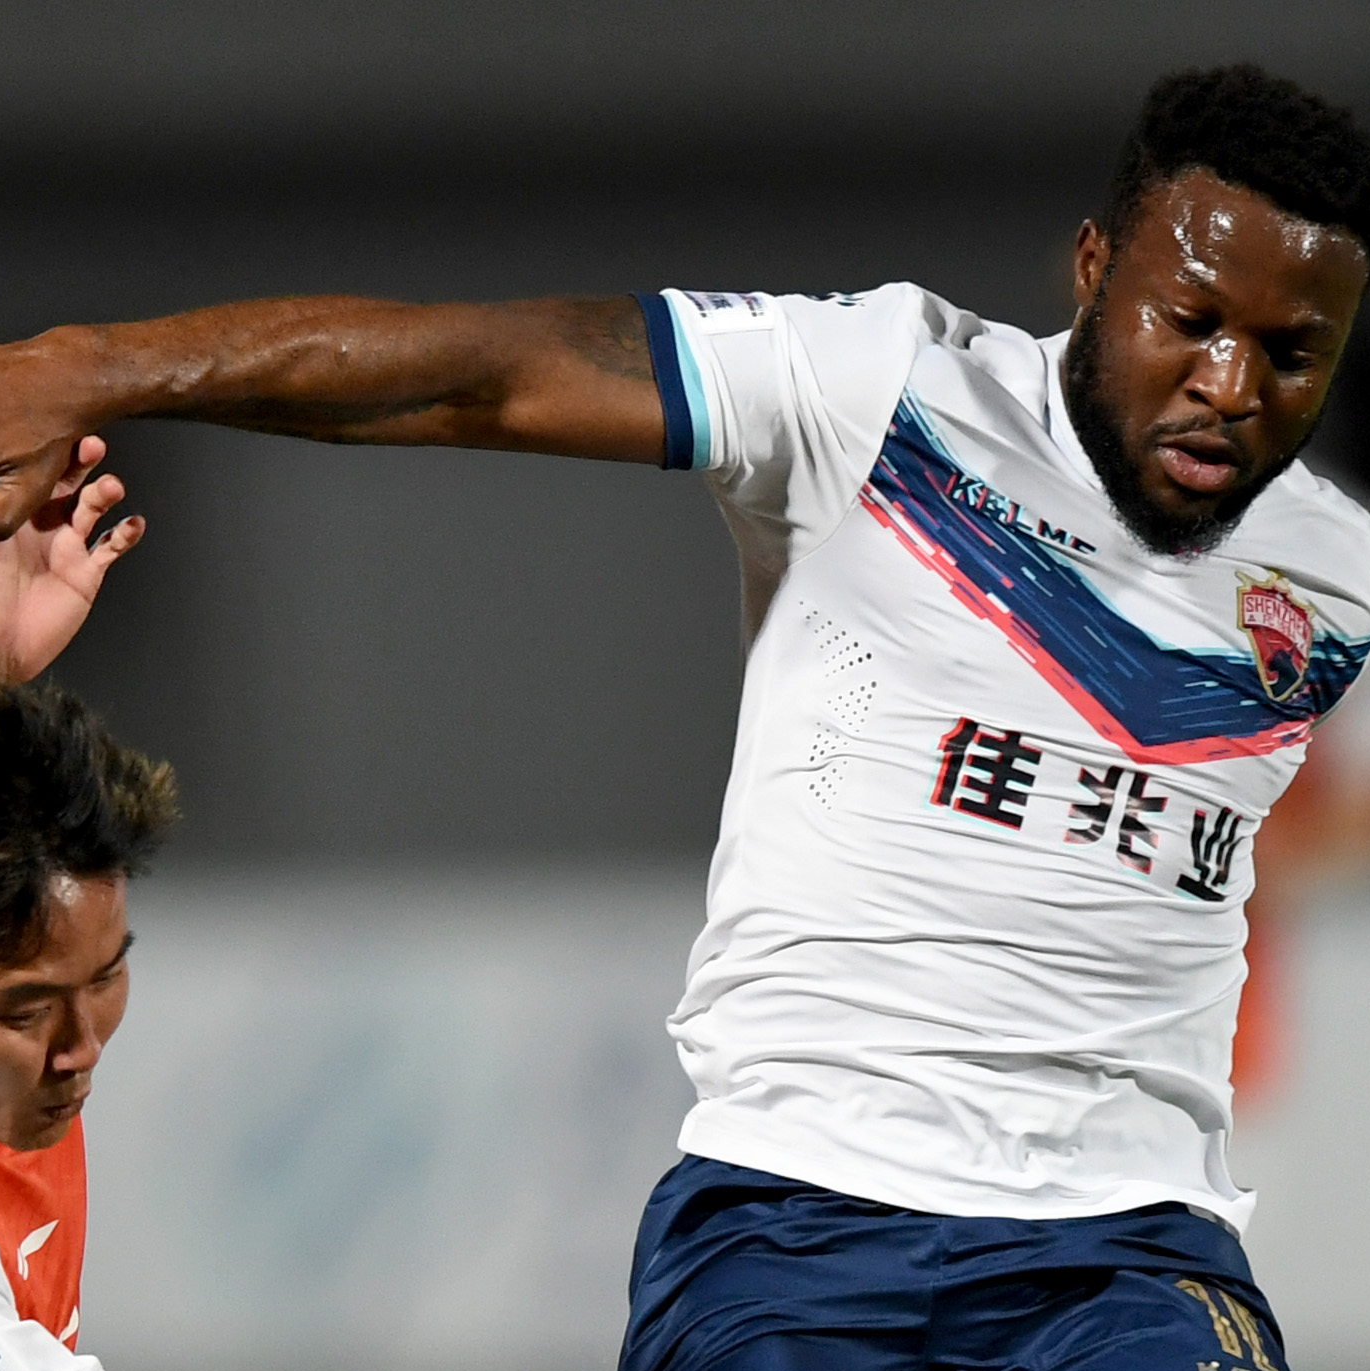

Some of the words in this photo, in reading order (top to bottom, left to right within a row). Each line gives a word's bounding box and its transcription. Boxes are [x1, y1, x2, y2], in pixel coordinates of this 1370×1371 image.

[943, 471, 1098, 554] KELME
[1245, 596, 1309, 641] SHENZHEN
[929, 716, 1243, 901] 佳兆业
